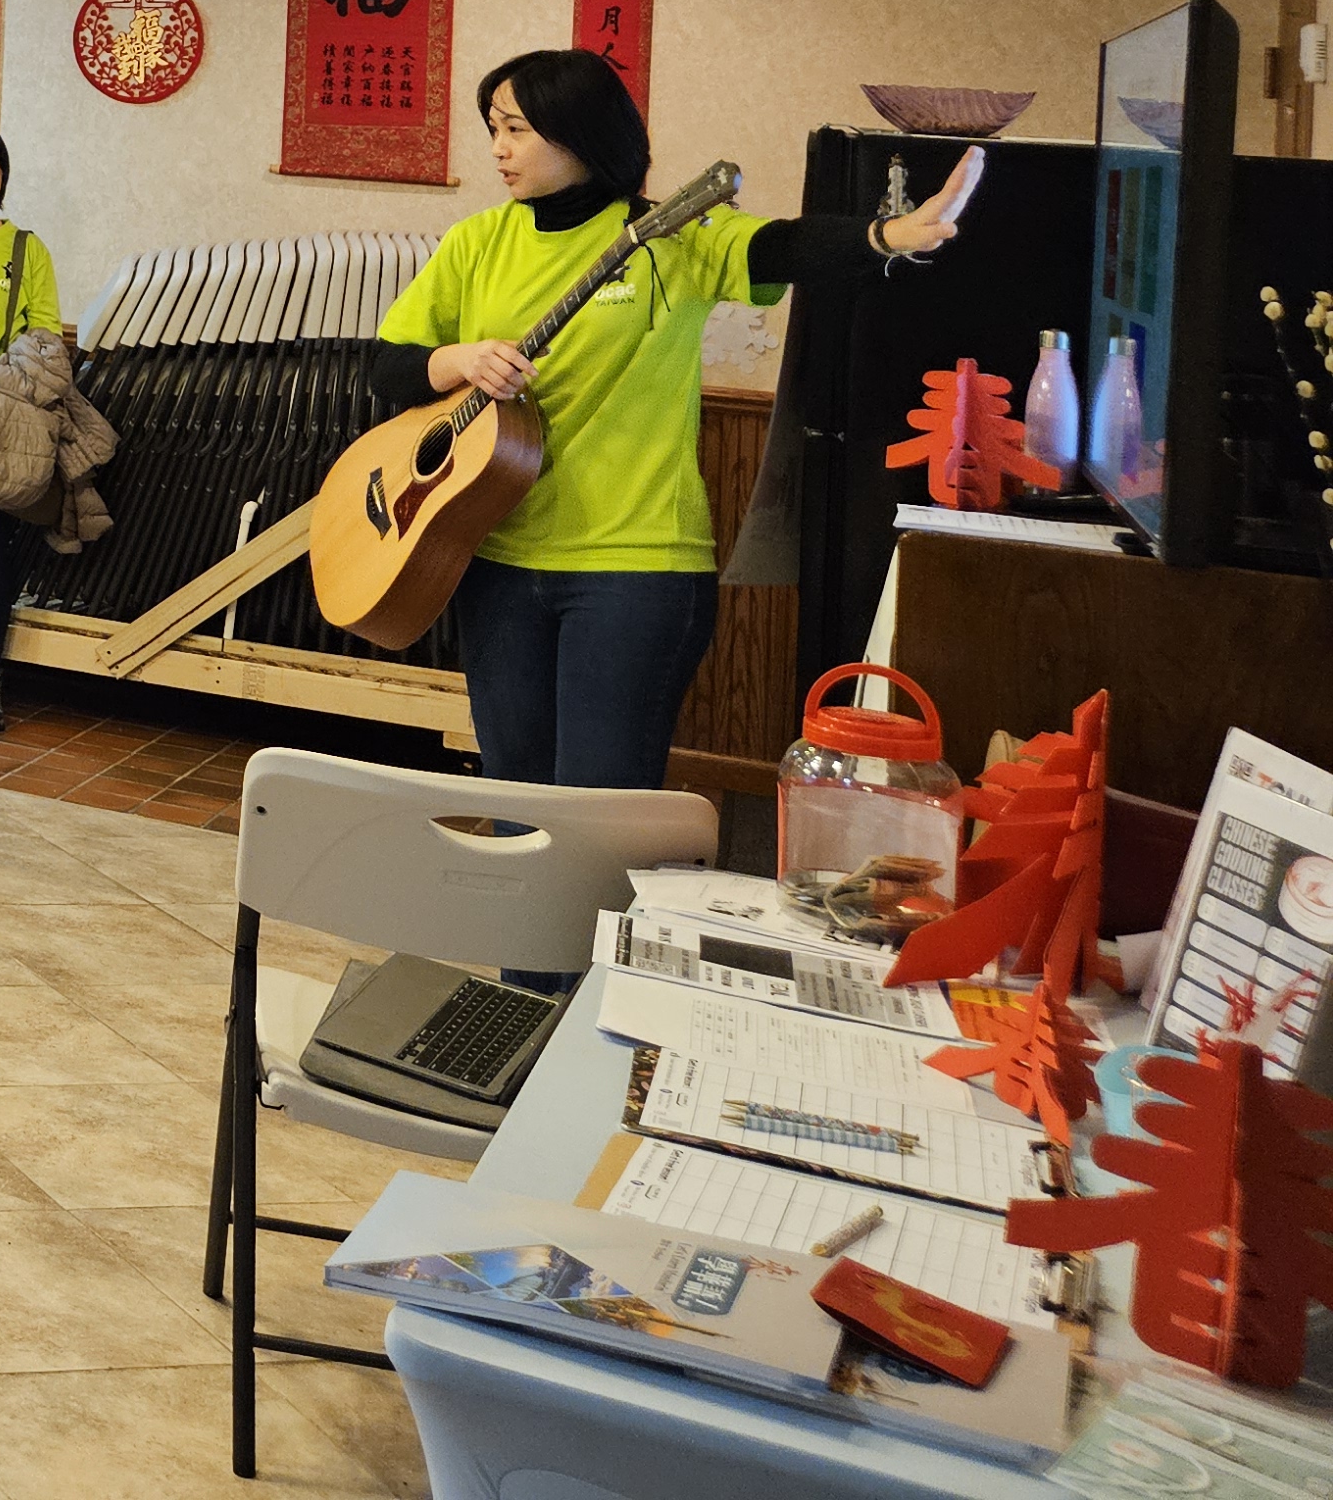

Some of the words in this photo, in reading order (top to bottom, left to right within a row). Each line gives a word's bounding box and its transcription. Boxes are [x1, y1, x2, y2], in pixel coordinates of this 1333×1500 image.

[596, 297, 636, 307] TAIWAN
[1221, 816, 1280, 860] CHINESE
[1214, 840, 1275, 888] COOKING
[1207, 865, 1267, 912] CLASSES
